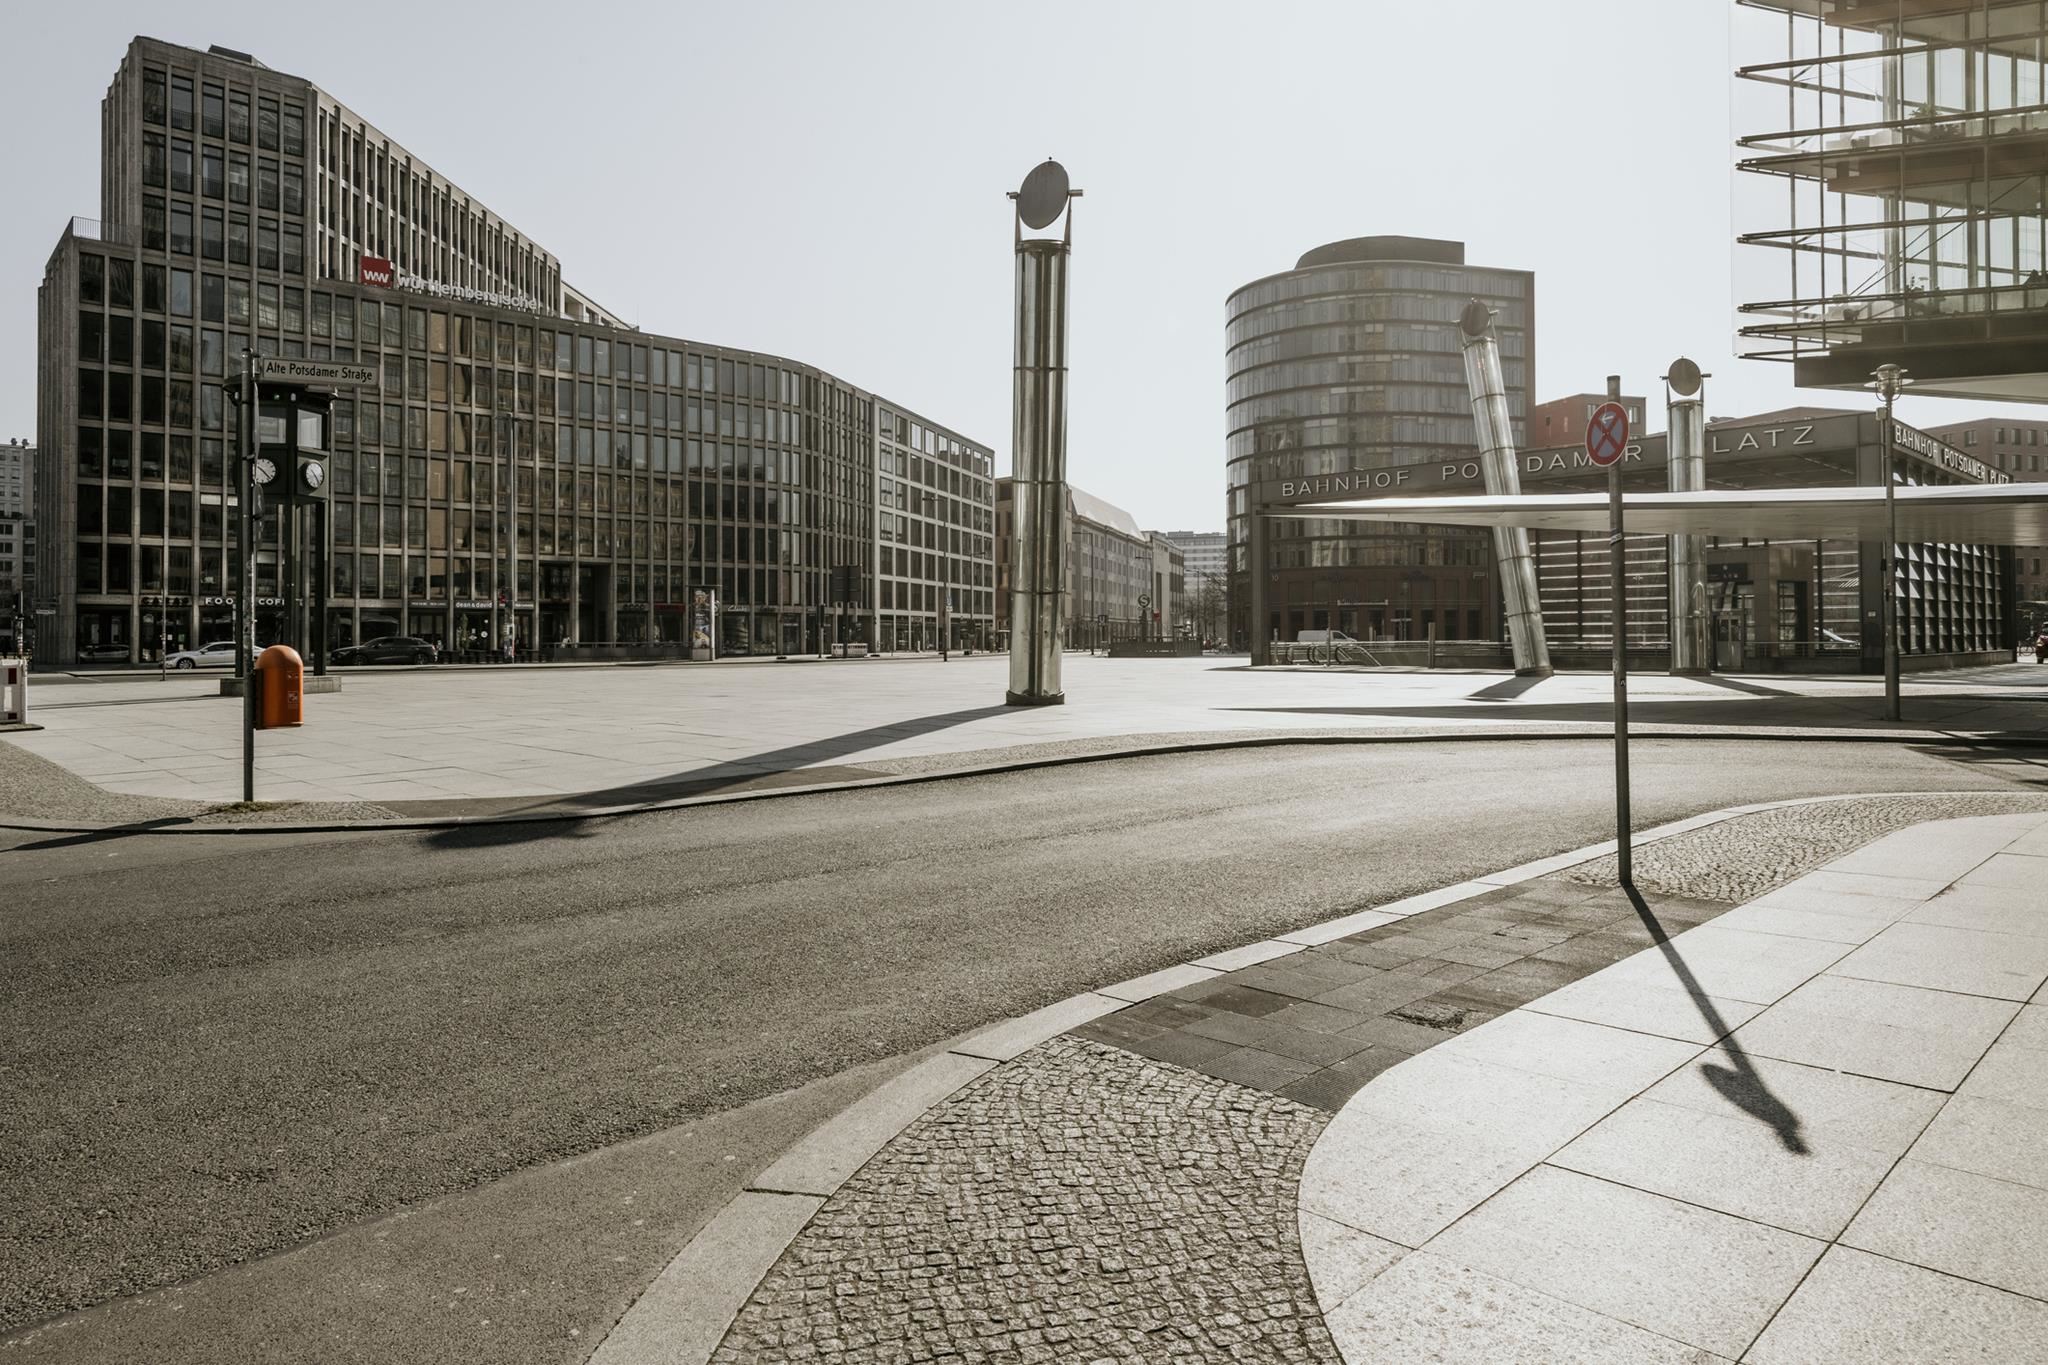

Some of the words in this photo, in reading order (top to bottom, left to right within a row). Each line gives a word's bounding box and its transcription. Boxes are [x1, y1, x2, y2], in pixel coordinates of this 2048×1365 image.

[266, 361, 286, 374] Alte
[289, 363, 339, 378] Potsdamer
[341, 367, 373, 382] Straße
[1282, 470, 1410, 497] BAHNHOF
[1442, 445, 1642, 481] PODAMR
[1713, 425, 1814, 453] LATZ
[1895, 425, 1938, 458] BAHNHOF
[1944, 448, 1986, 479] POTSDAMER
